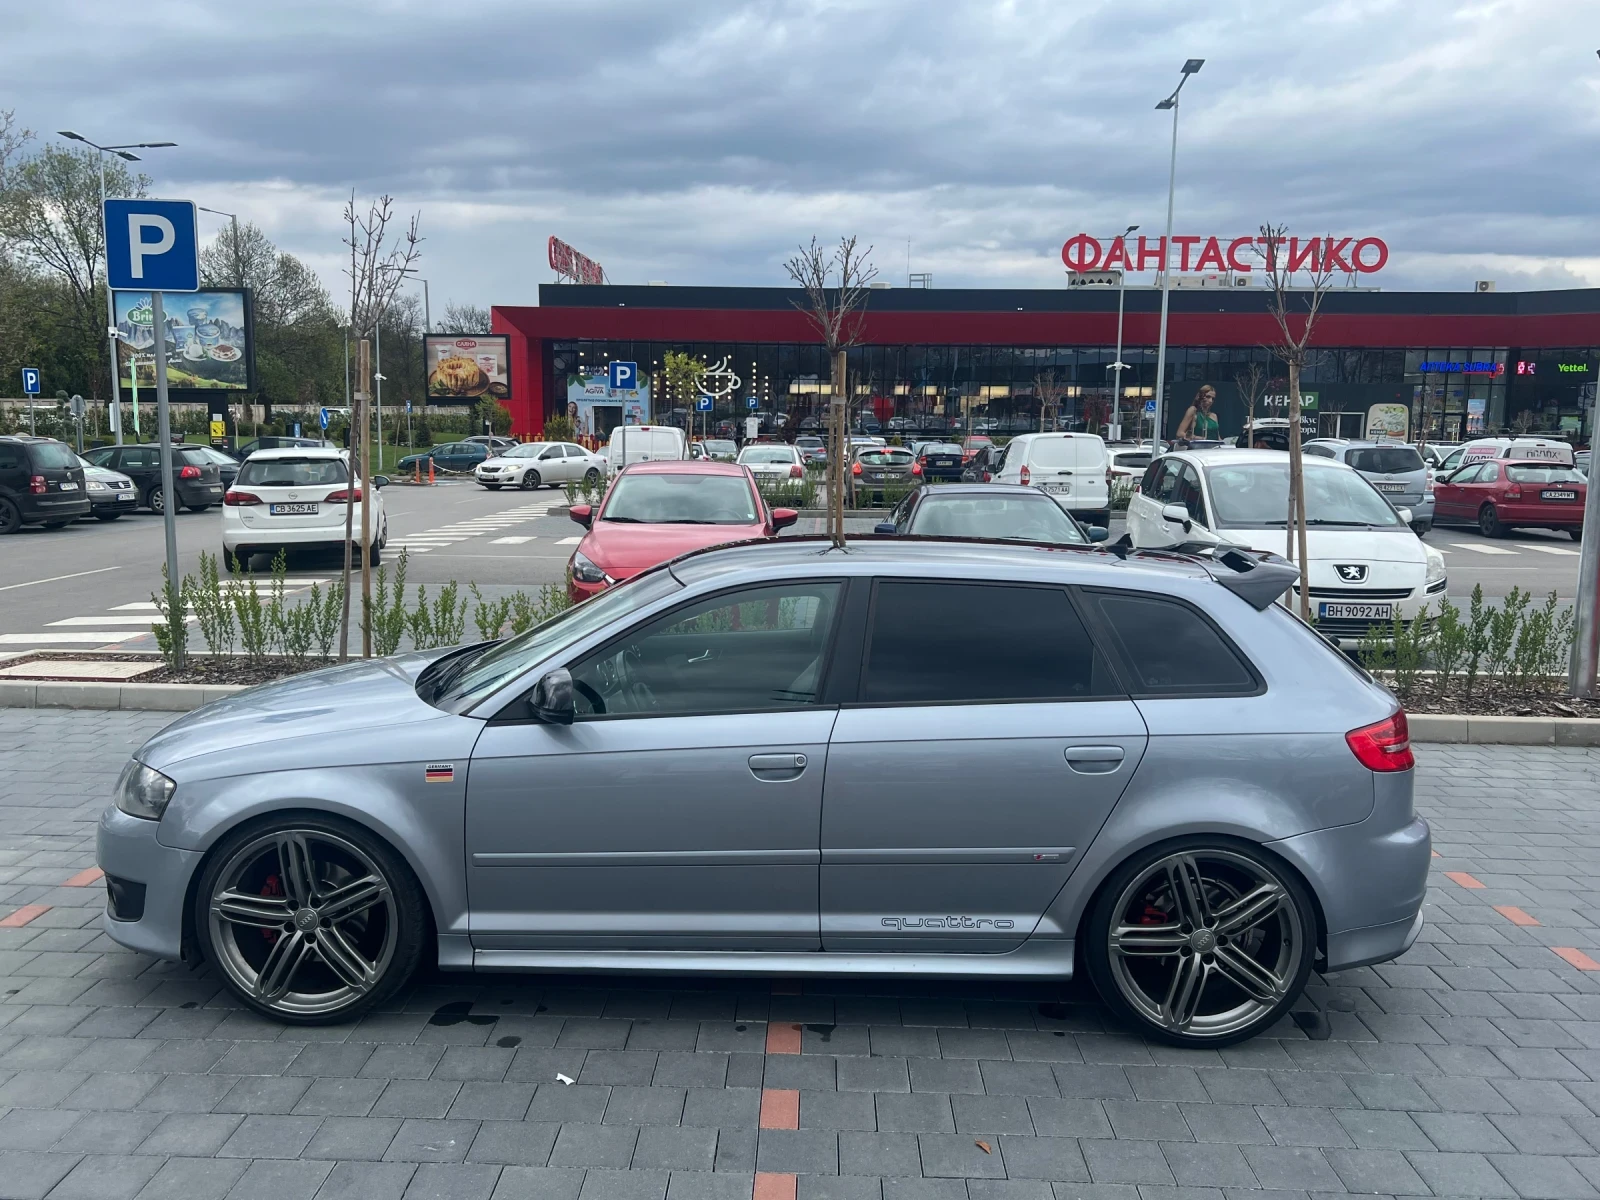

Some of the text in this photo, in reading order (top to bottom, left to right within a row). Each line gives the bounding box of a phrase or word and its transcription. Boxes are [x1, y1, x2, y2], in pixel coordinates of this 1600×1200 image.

[128, 214, 176, 279] P
[1061, 233, 1389, 274] ФАНТАСТИКО
[1420, 362, 1497, 372] АПТЕКА SUBRA
[1558, 363, 1589, 372] Yettel.
[27, 372, 36, 390] P
[616, 366, 631, 386] P
[700, 398, 709, 409] P
[749, 399, 756, 407] P
[275, 504, 317, 513] CB 3625 AE
[1327, 605, 1389, 617] BH 9092 AH
[881, 915, 1015, 931] quattro
